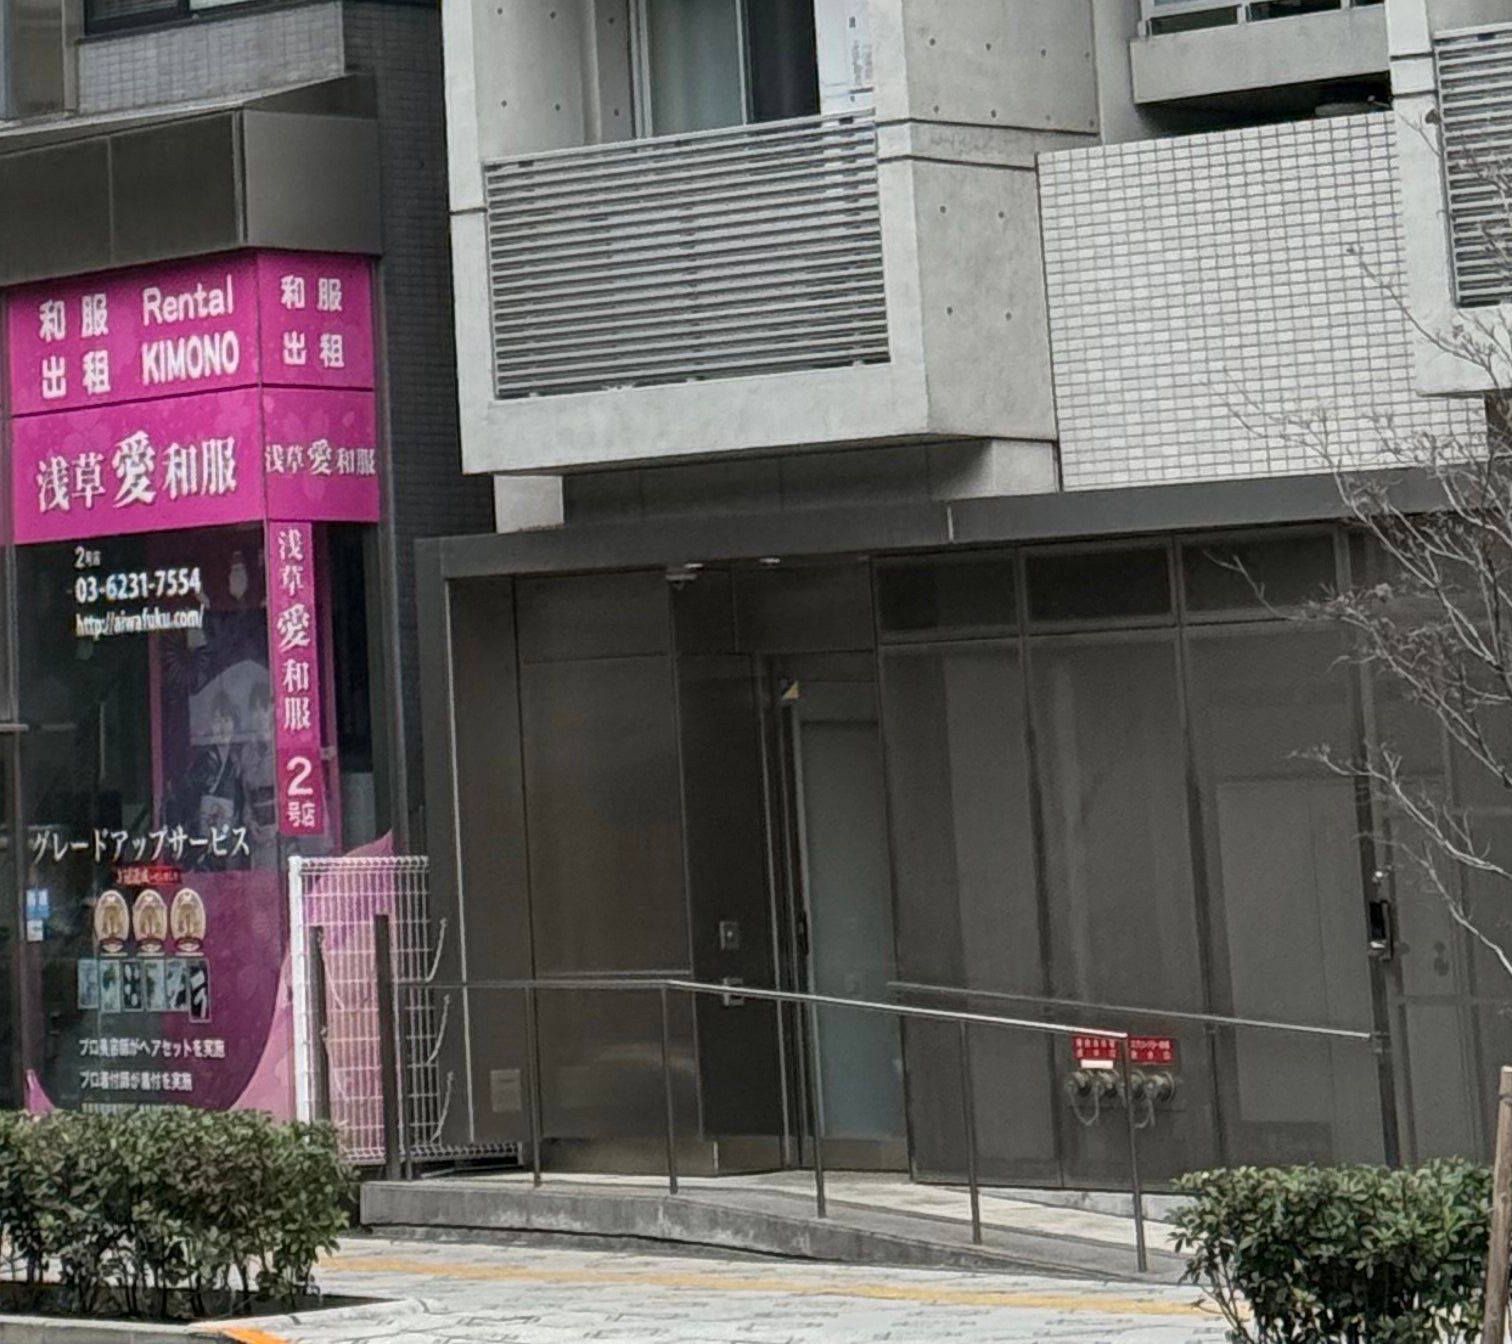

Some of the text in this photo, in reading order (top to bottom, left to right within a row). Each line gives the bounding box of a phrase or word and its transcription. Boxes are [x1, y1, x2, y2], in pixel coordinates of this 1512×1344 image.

[142, 274, 234, 327] Rental
[280, 274, 343, 313] 和服
[39, 292, 110, 343] 和服
[141, 330, 240, 386] KIMONO
[283, 331, 346, 369] 出租
[41, 349, 111, 400] 出租
[36, 429, 238, 514] 浅草愛和服
[264, 438, 377, 477] 浅草愛和服
[75, 566, 202, 604] 03-6231-7554
[31, 825, 250, 864] グレードアップサービス
